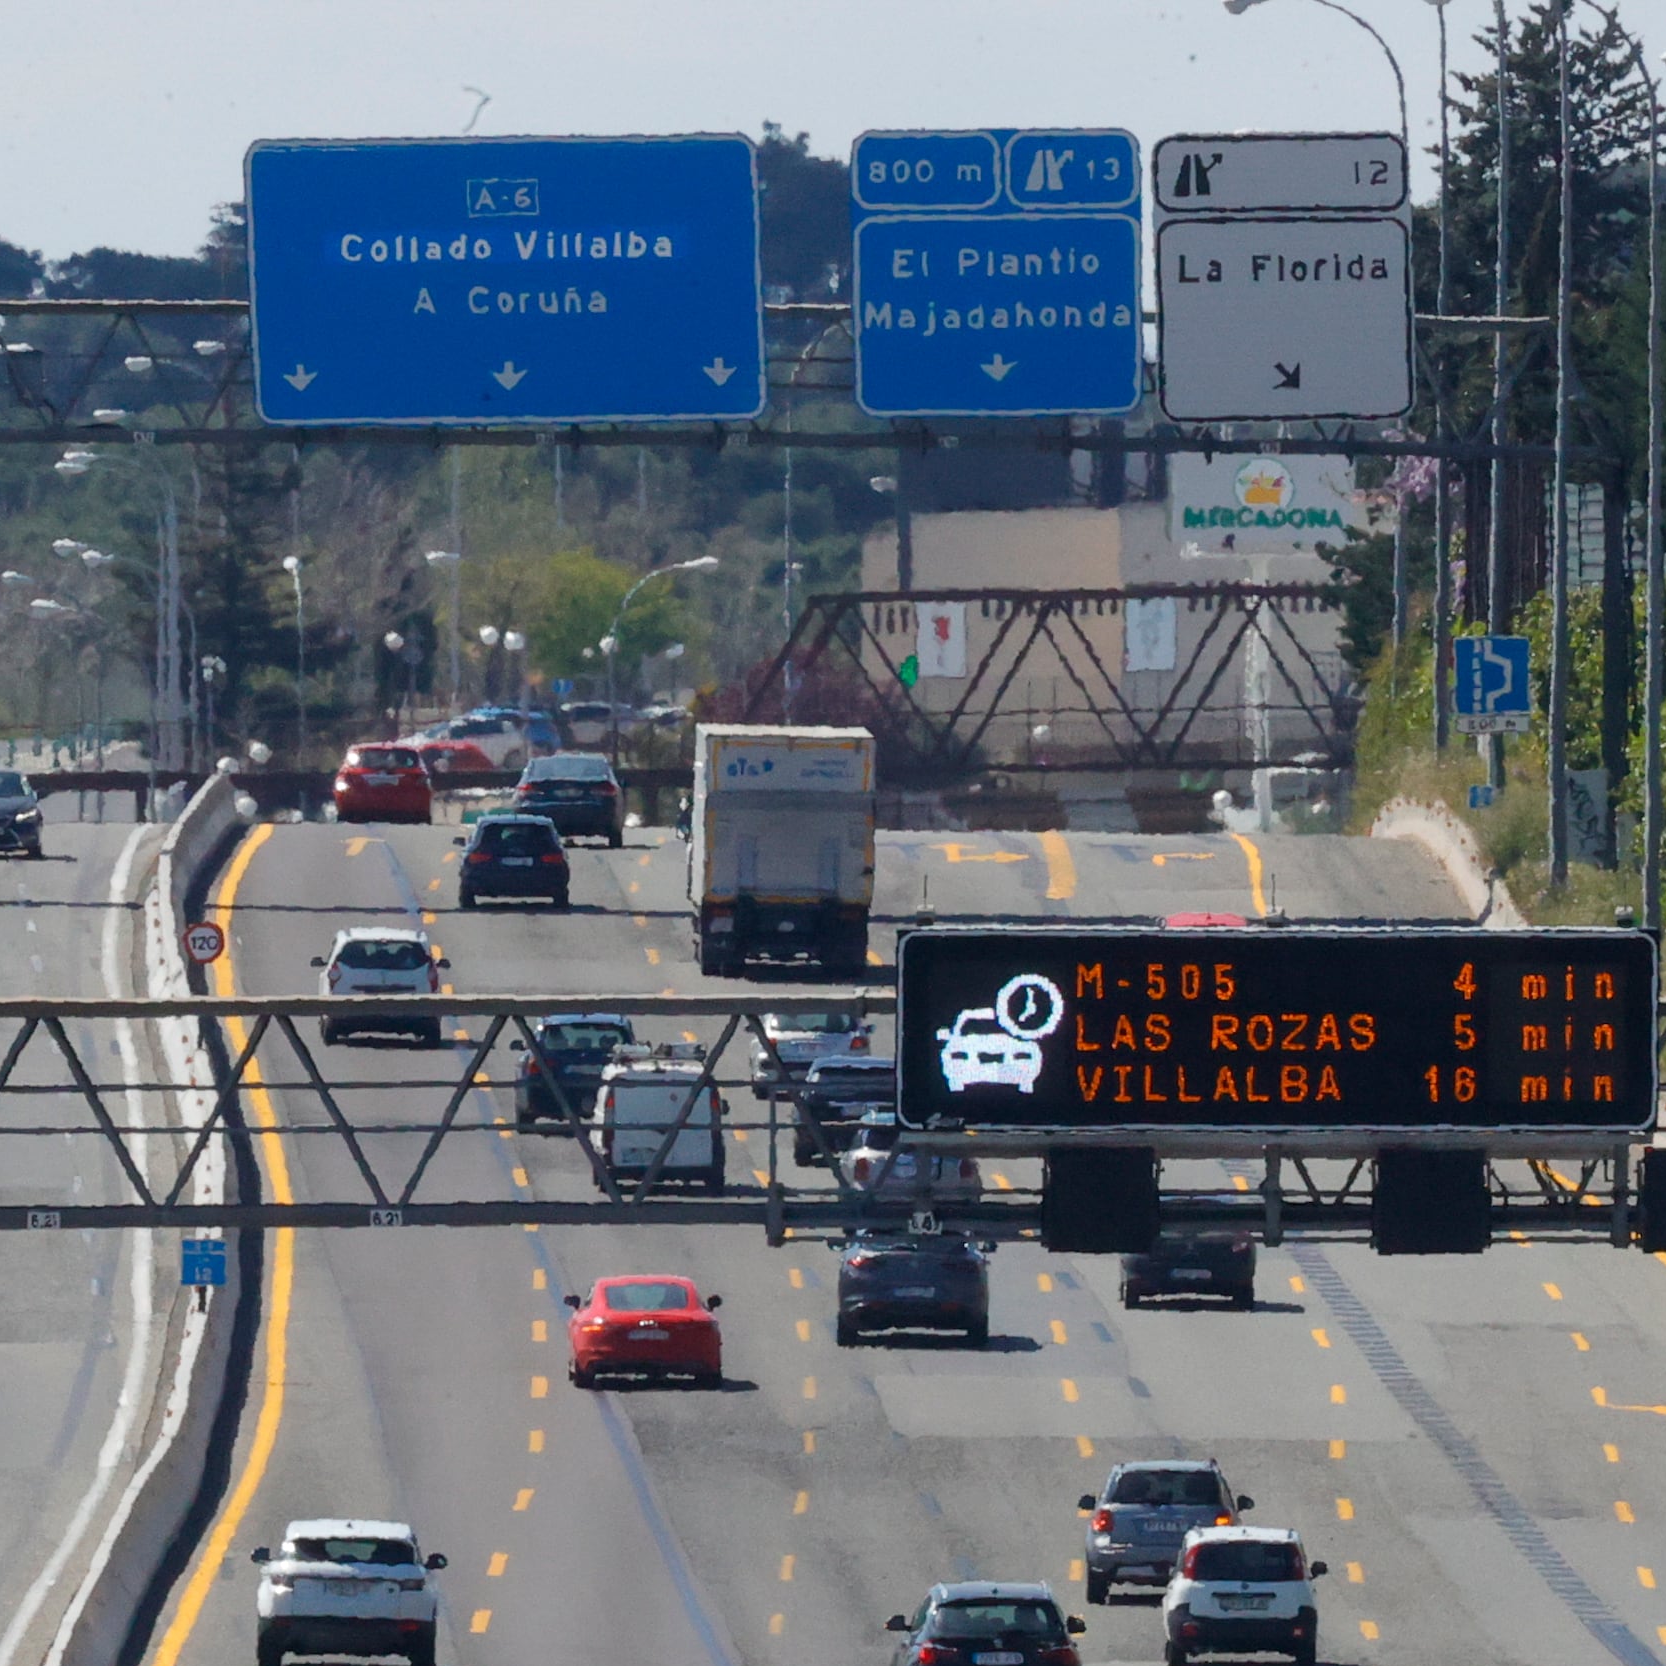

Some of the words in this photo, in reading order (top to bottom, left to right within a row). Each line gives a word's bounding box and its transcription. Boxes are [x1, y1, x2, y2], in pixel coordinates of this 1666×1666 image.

[869, 159, 934, 184] 800
[956, 164, 982, 182] m
[1087, 157, 1120, 181] 13
[1354, 160, 1388, 186] 12
[475, 186, 531, 210] A-6
[341, 233, 493, 263] Collado
[514, 230, 673, 260] Villalba
[892, 249, 929, 278] El
[1178, 254, 1222, 284] La
[1252, 252, 1389, 282] Florida
[414, 287, 436, 314] A
[468, 286, 607, 314] Coruña
[864, 301, 1132, 337] Majadahonda
[1183, 506, 1343, 529] MERCADONA
[191, 935, 218, 951] 120
[1075, 962, 1237, 1002] M-505
[1452, 962, 1477, 1002] 4
[1521, 965, 1616, 1002] min
[1076, 1013, 1172, 1052] LAS
[1211, 1013, 1377, 1052] ROZAS
[1453, 1013, 1477, 1052] 5
[1521, 1016, 1615, 1052] min
[1076, 1064, 1343, 1103] VILLALBA
[1424, 1064, 1477, 1103] 16
[1521, 1067, 1615, 1103] min
